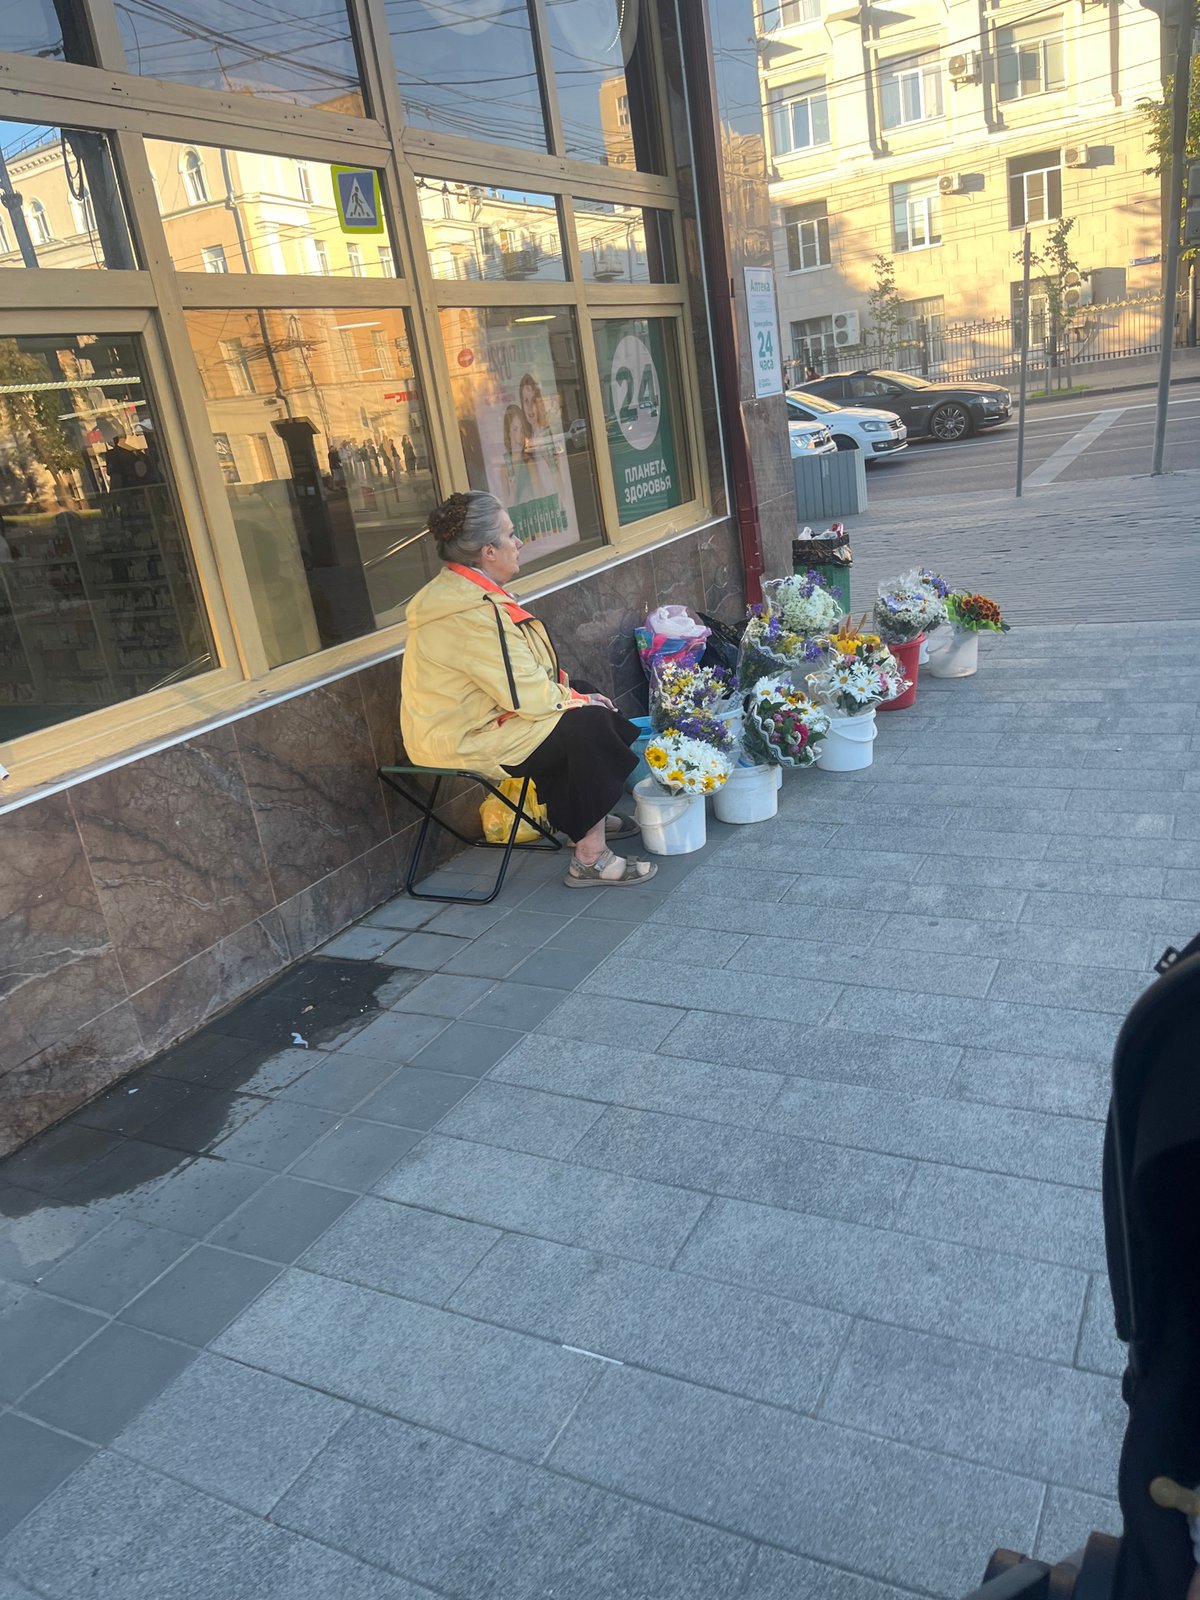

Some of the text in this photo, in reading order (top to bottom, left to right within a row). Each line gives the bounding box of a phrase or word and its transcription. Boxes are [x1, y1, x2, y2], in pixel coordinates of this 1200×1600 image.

[750, 279, 771, 293] Аптека
[757, 331, 774, 358] 24
[759, 358, 774, 371] часа
[624, 458, 667, 484] ПЛАНЕТА
[624, 475, 672, 504] ЗДОРОВЬЯ
